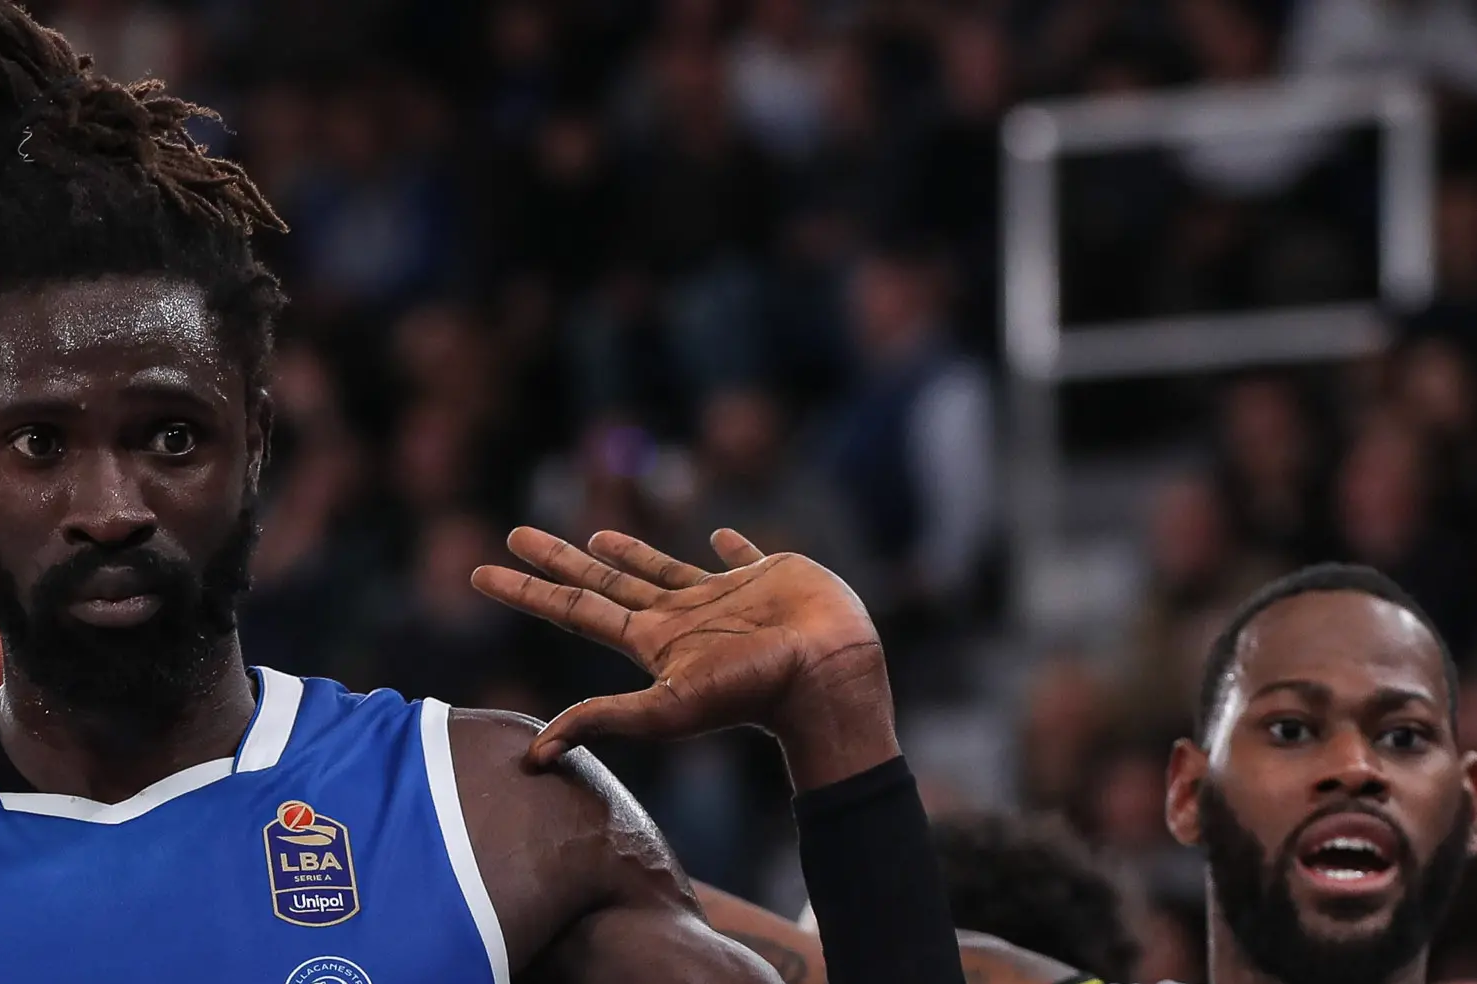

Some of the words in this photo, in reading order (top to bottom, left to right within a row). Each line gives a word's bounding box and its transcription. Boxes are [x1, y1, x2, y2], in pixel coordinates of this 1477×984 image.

[280, 852, 343, 872] LBA
[294, 874, 322, 883] SERIE
[324, 874, 332, 882] A
[291, 892, 344, 912] Unipol
